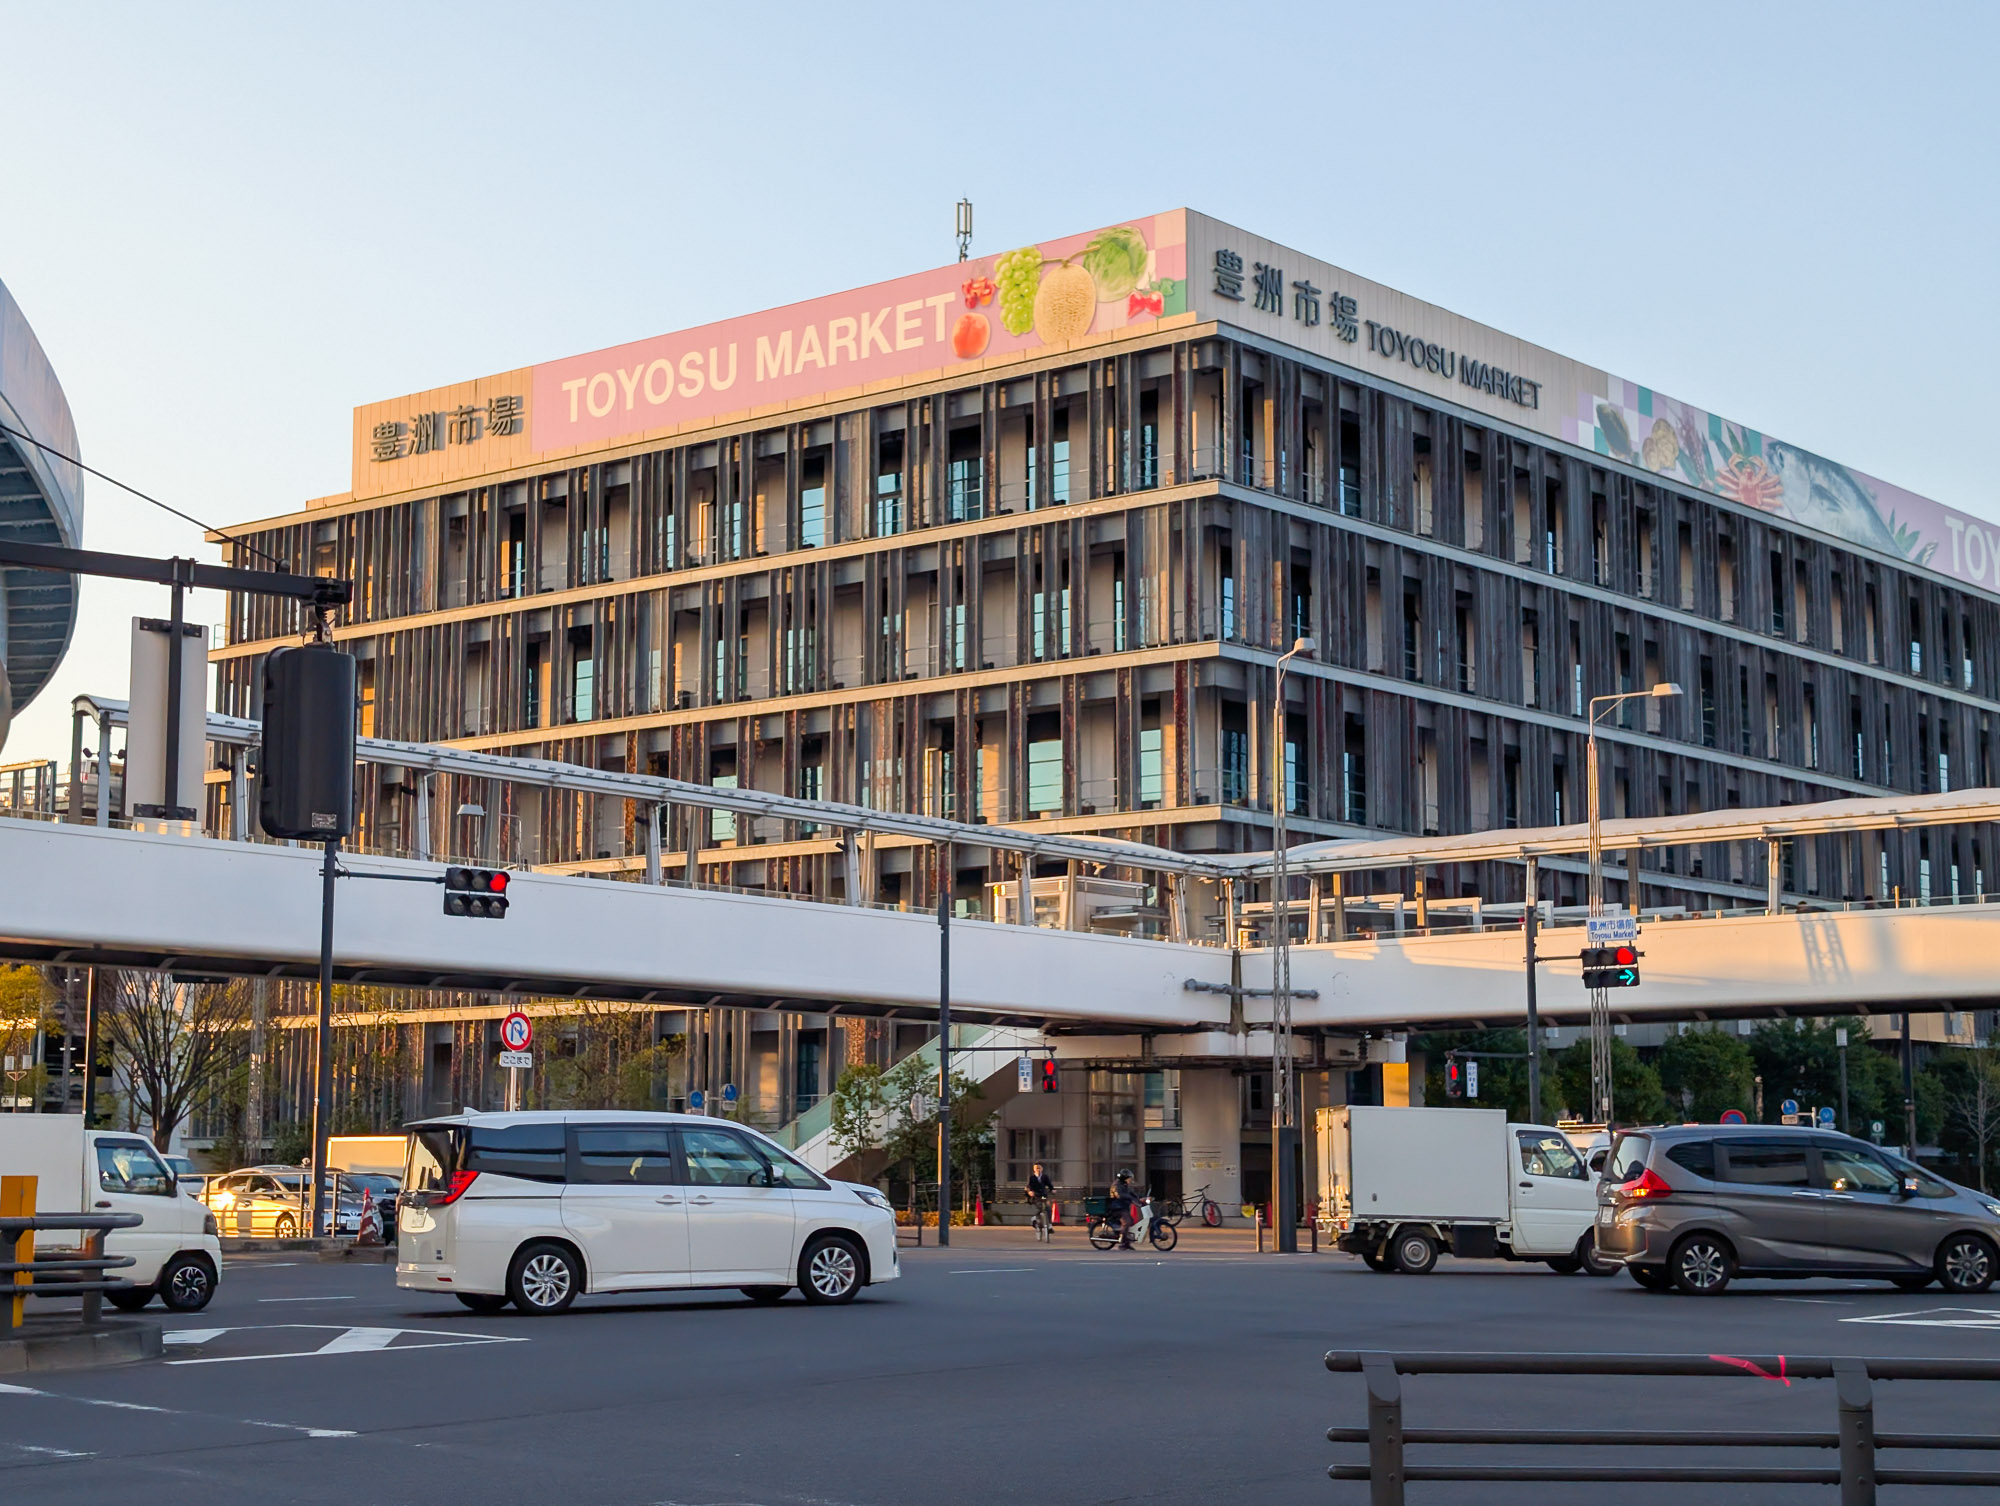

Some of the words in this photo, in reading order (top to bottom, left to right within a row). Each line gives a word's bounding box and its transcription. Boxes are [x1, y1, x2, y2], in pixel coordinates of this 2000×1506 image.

[1213, 248, 1360, 344] 豊洲市場
[1365, 319, 1455, 379] TOYOSU
[1459, 355, 1543, 410] MARKET
[561, 342, 738, 423] TOYOSU
[755, 291, 957, 383] MARKET
[370, 395, 519, 463] 豊洲市場
[1588, 918, 1634, 931] 豊洲市場前
[1591, 931, 1612, 940] Toyosu
[1613, 930, 1634, 939] Market
[503, 1055, 530, 1065] ここまで
